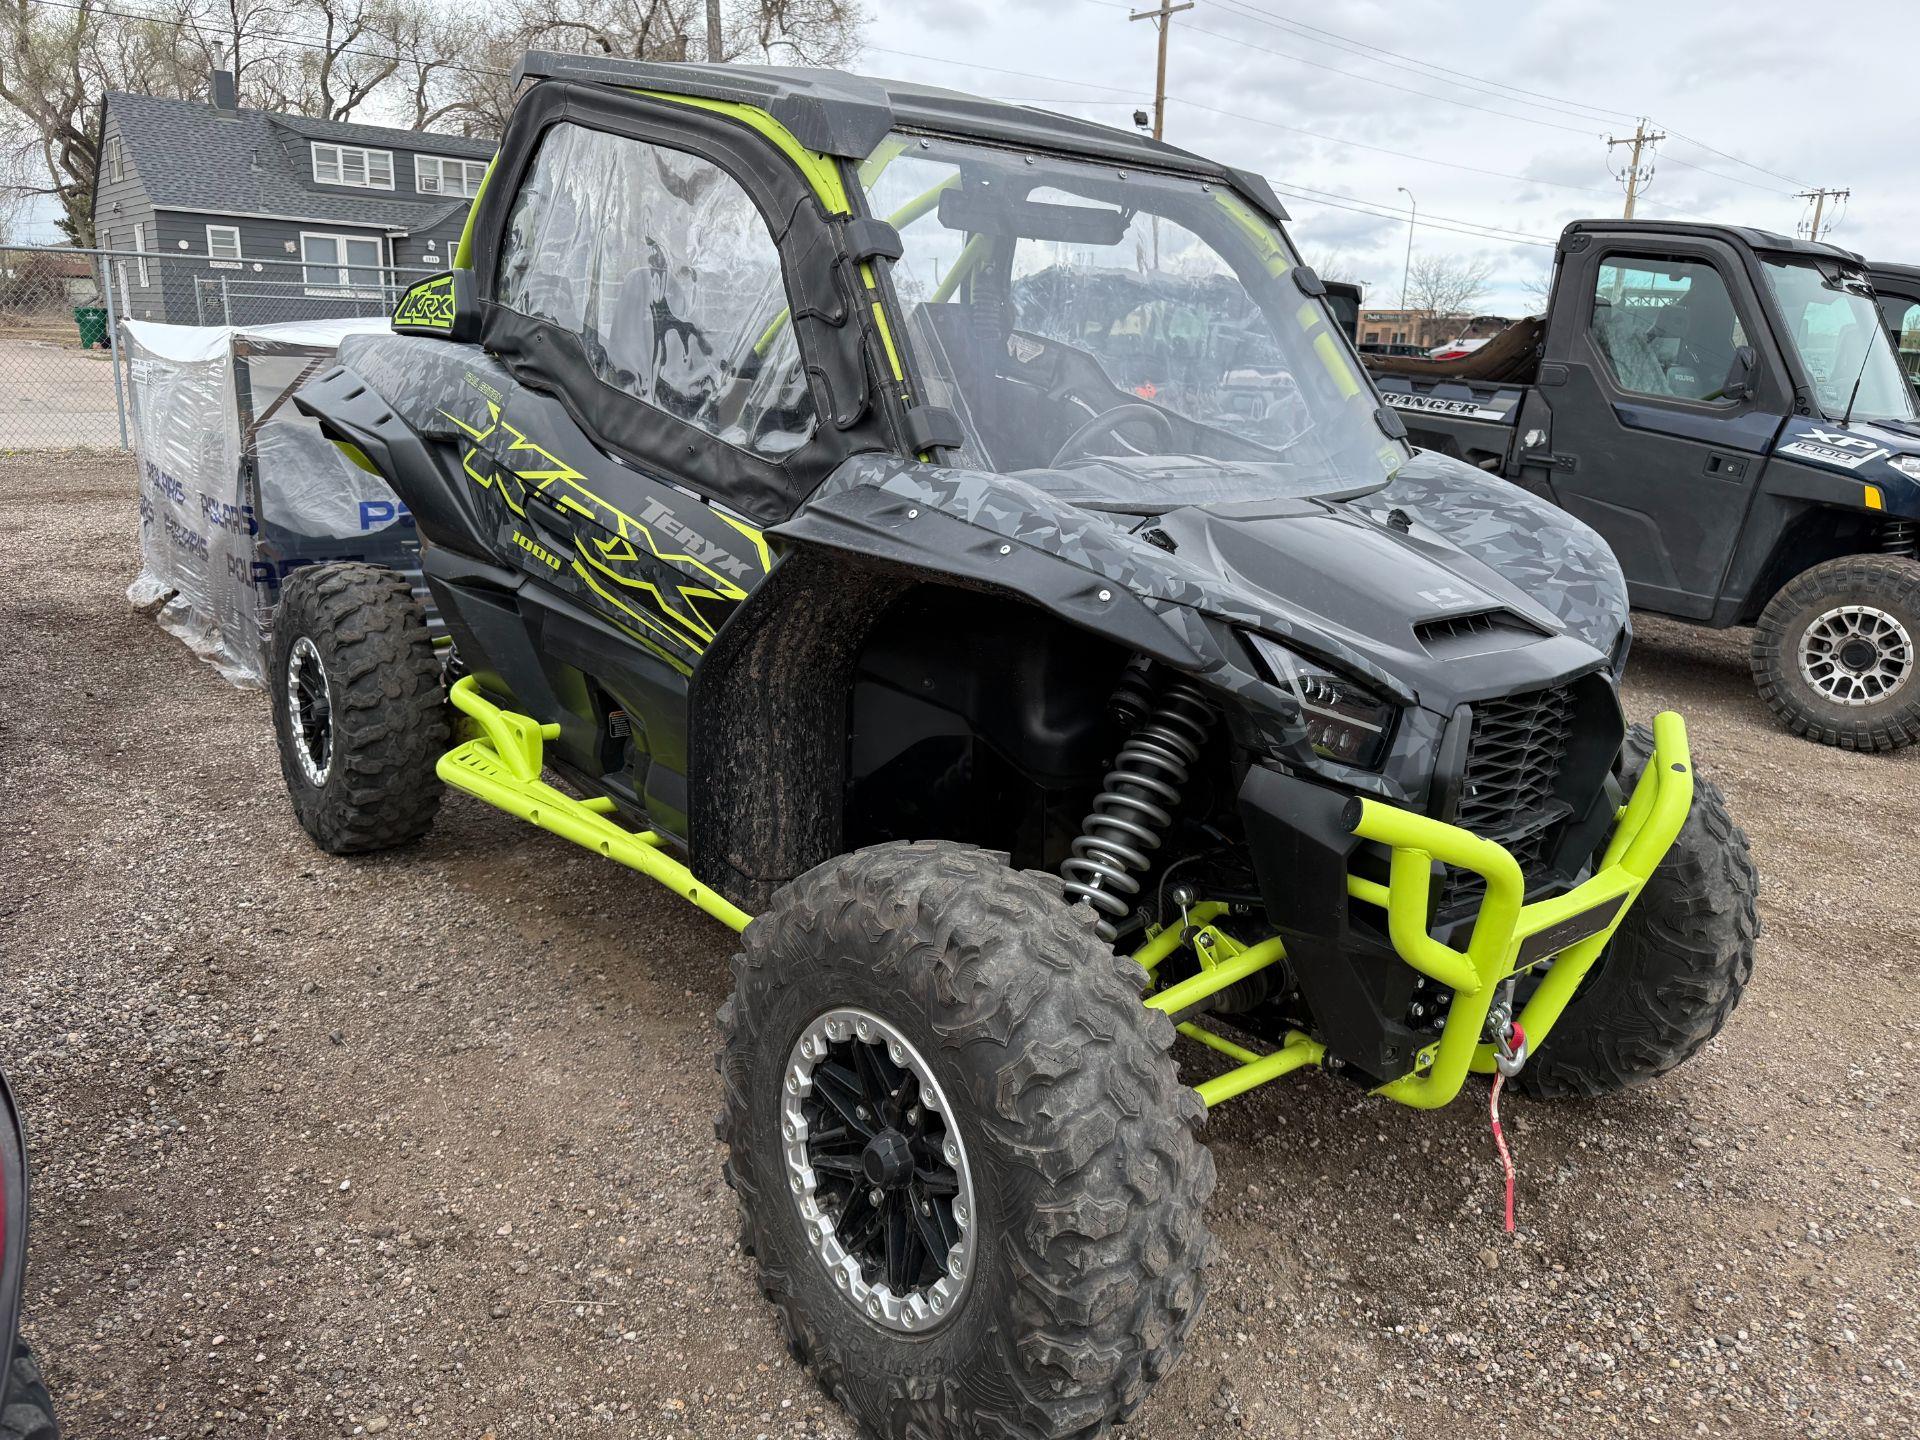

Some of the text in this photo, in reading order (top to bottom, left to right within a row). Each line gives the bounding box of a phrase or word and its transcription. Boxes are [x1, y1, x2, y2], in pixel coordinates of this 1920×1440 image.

[404, 292, 455, 319] KRX
[1382, 393, 1479, 416] RANGER
[1795, 427, 1878, 449] XP
[1794, 442, 1853, 461] 1000
[200, 493, 258, 536] POLARIS
[512, 529, 561, 571] 1000
